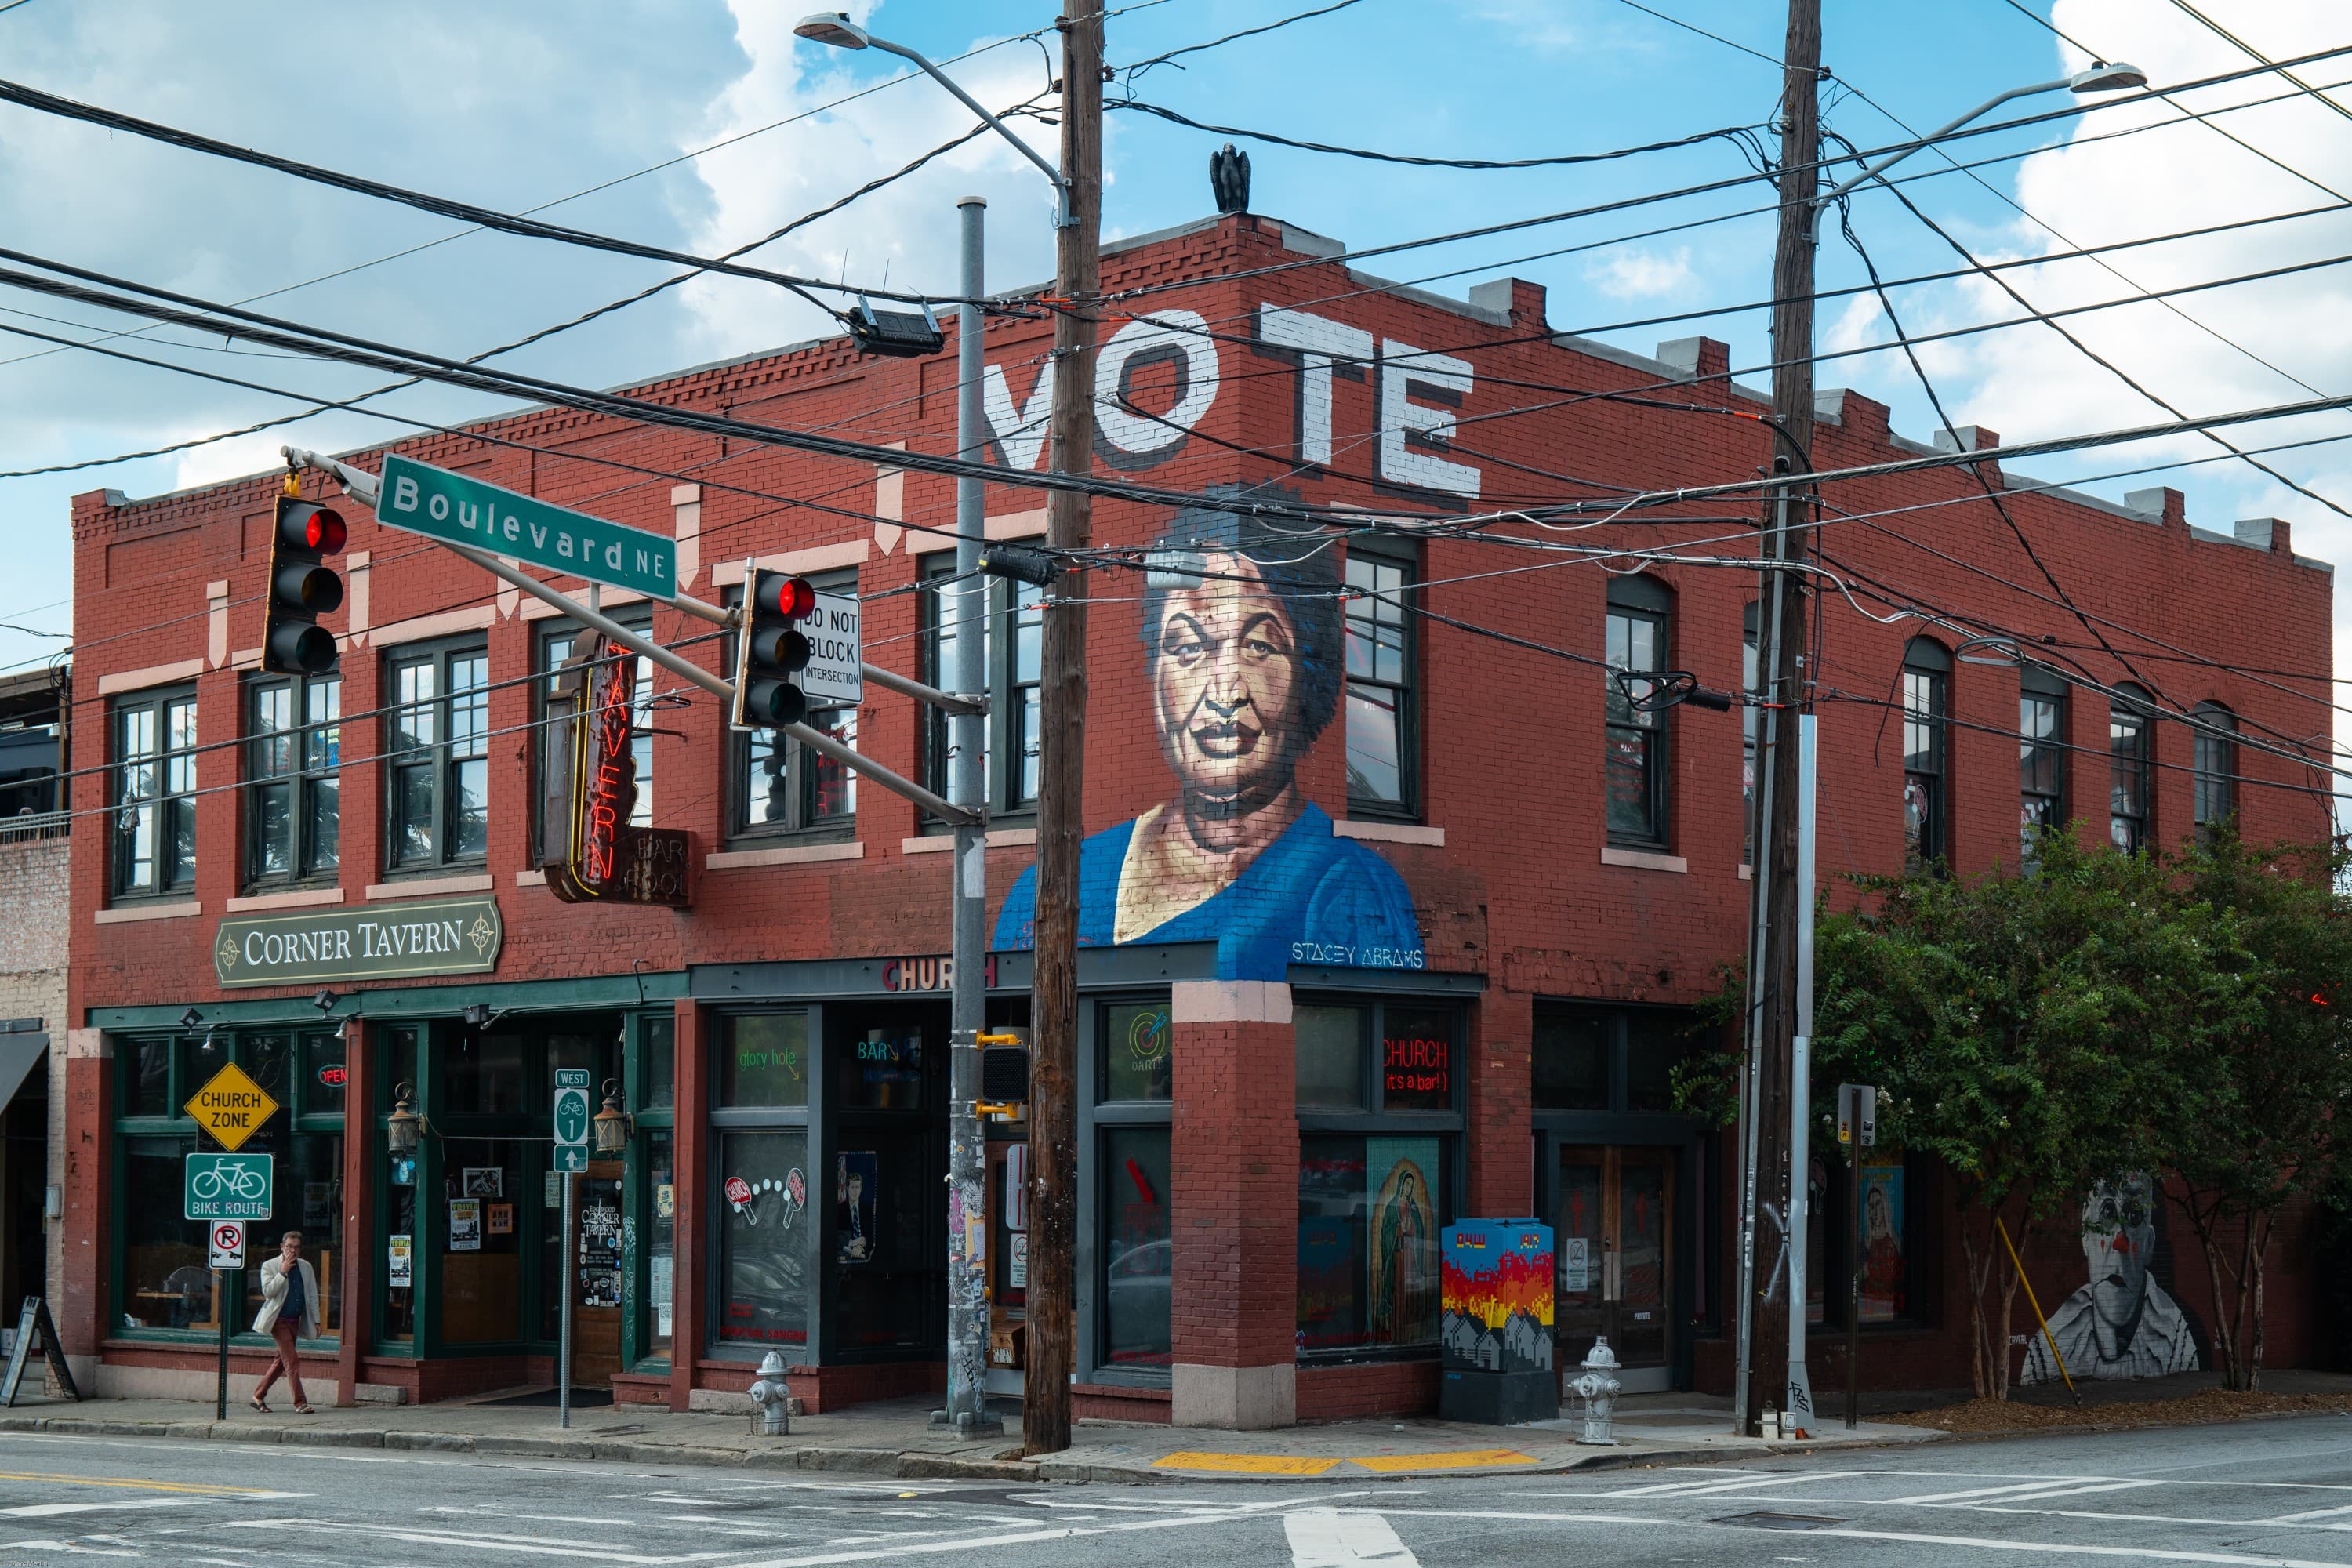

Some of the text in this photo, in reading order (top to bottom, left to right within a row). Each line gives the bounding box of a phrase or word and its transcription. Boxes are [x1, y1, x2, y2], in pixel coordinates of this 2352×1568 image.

[983, 302, 1481, 499] VOTE
[394, 475, 665, 579] Boulevard NE
[804, 607, 857, 634] DO NOT
[807, 636, 855, 664] BLOCK
[805, 666, 859, 686] INTERSECTION
[589, 643, 633, 879] TAVERN
[637, 838, 684, 862] BAR
[244, 920, 463, 966] CORNER TAVERN
[1292, 942, 1424, 969] STACEY ABRAMS
[882, 955, 996, 991] CHURH
[739, 1047, 797, 1072] glory hole
[858, 1041, 887, 1061] BAR
[1383, 1039, 1447, 1069] CHURCH
[319, 1069, 347, 1083] OPEN
[561, 1073, 584, 1084] WEST
[1406, 1075, 1414, 1089] a
[201, 1091, 261, 1109] CHURCH
[211, 1112, 250, 1128] ZONE
[568, 1119, 574, 1139] 1
[727, 1180, 751, 1201] CHURCH
[192, 1201, 220, 1215] BIKE
[452, 1203, 478, 1211] TRIVIA
[582, 1210, 620, 1225] CORNER
[583, 1224, 617, 1237] TAVERN
